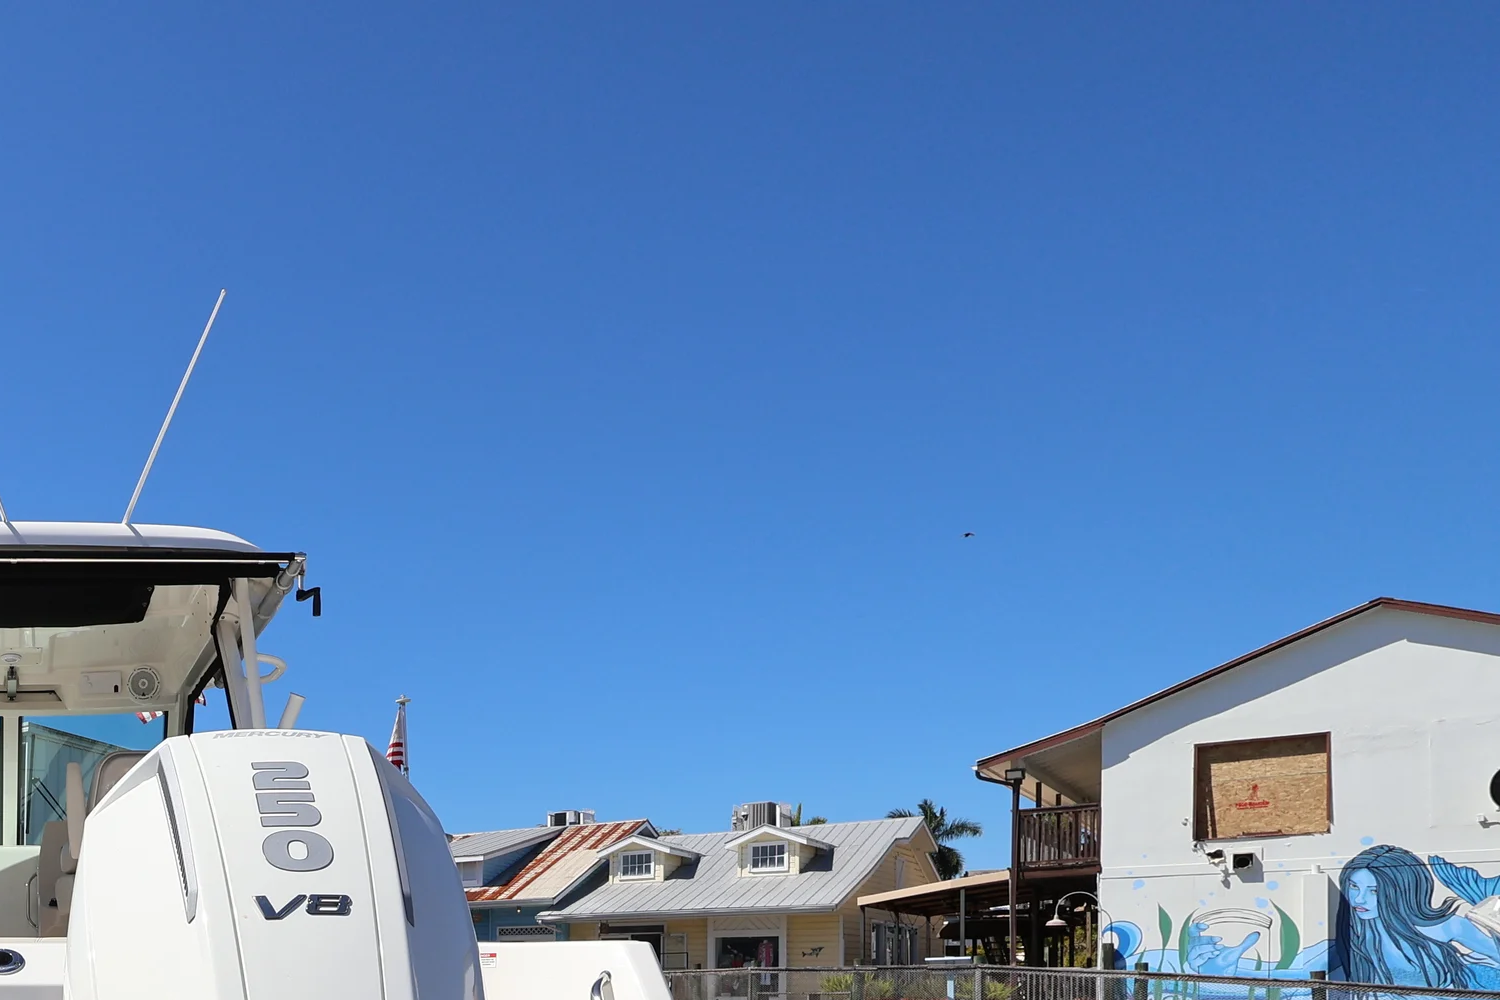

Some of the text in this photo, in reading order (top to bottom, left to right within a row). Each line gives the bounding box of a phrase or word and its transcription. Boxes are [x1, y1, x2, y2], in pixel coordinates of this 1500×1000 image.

[212, 731, 329, 740] MERCURY
[251, 761, 335, 872] 250
[252, 894, 353, 921] V8
